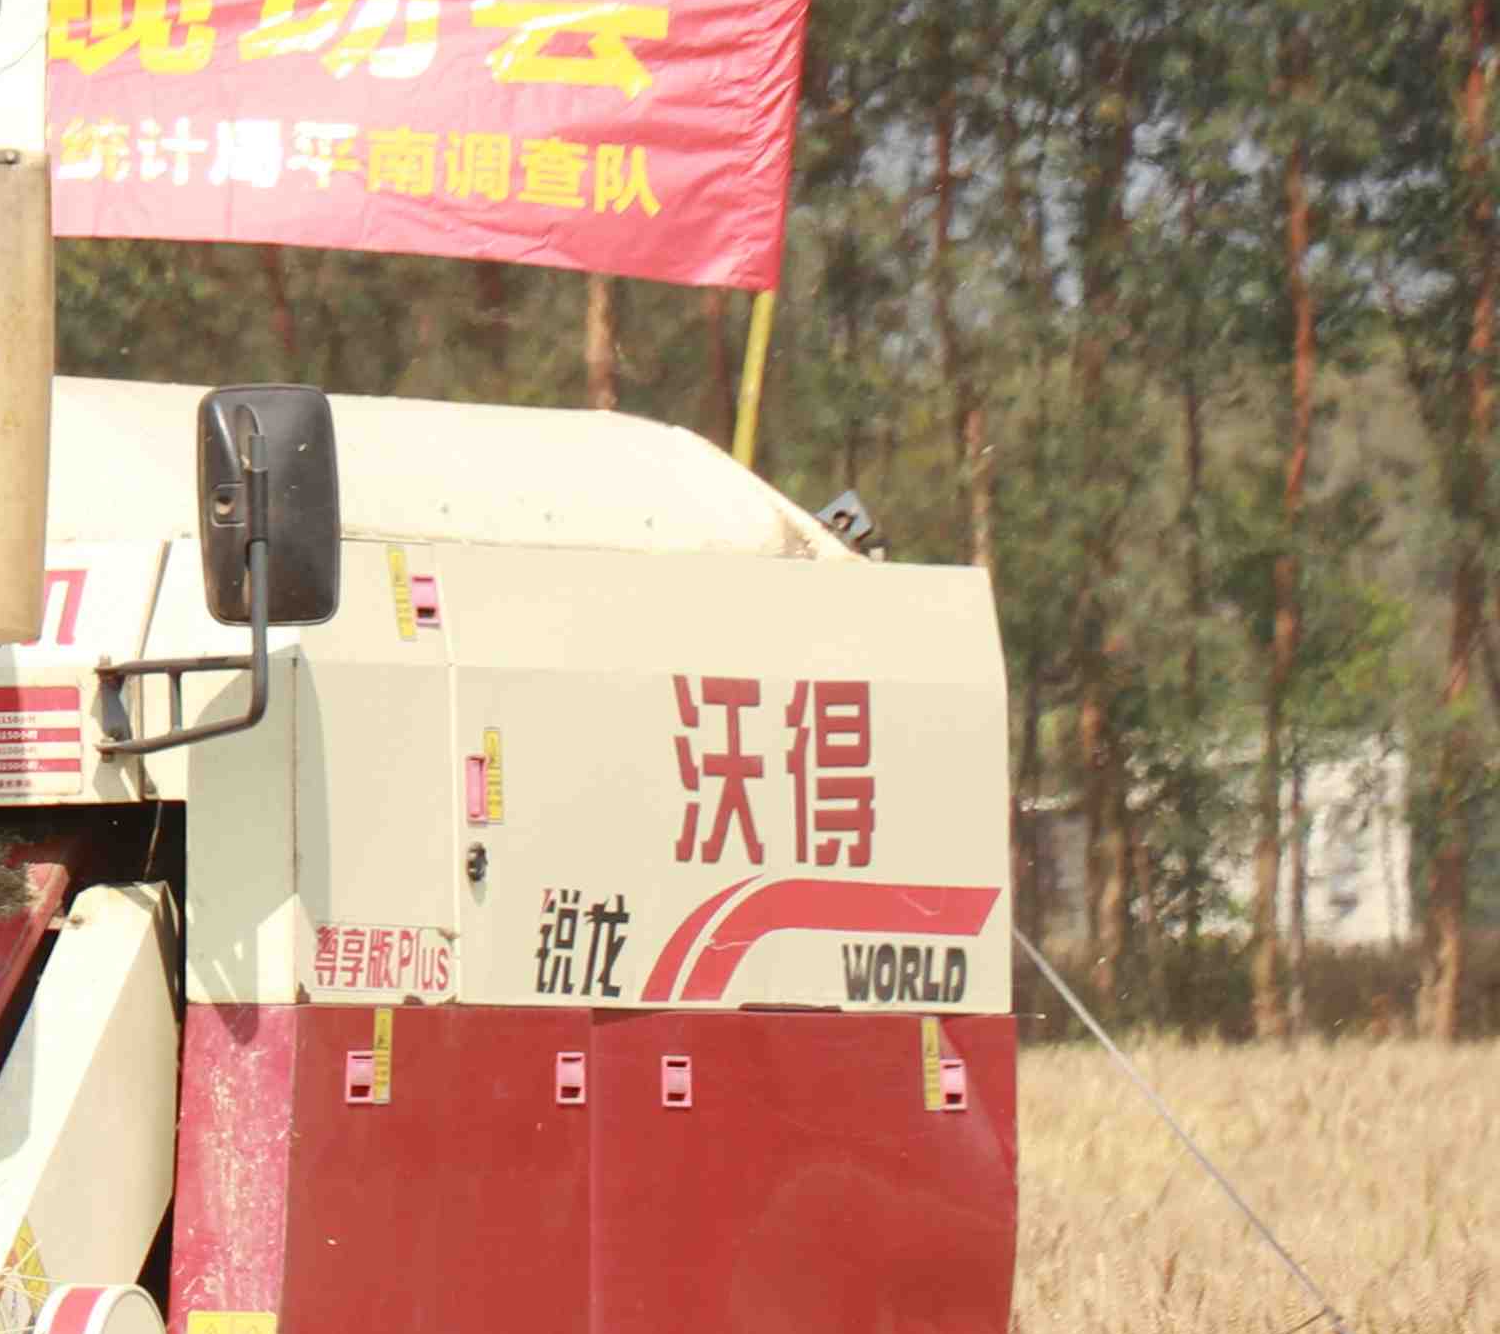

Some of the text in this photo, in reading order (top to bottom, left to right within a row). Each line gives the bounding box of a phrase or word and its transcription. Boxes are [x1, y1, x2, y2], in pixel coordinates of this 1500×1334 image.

[672, 673, 877, 868] 沃得
[535, 888, 631, 998] 锐龙
[841, 943, 968, 1002] WORLD
